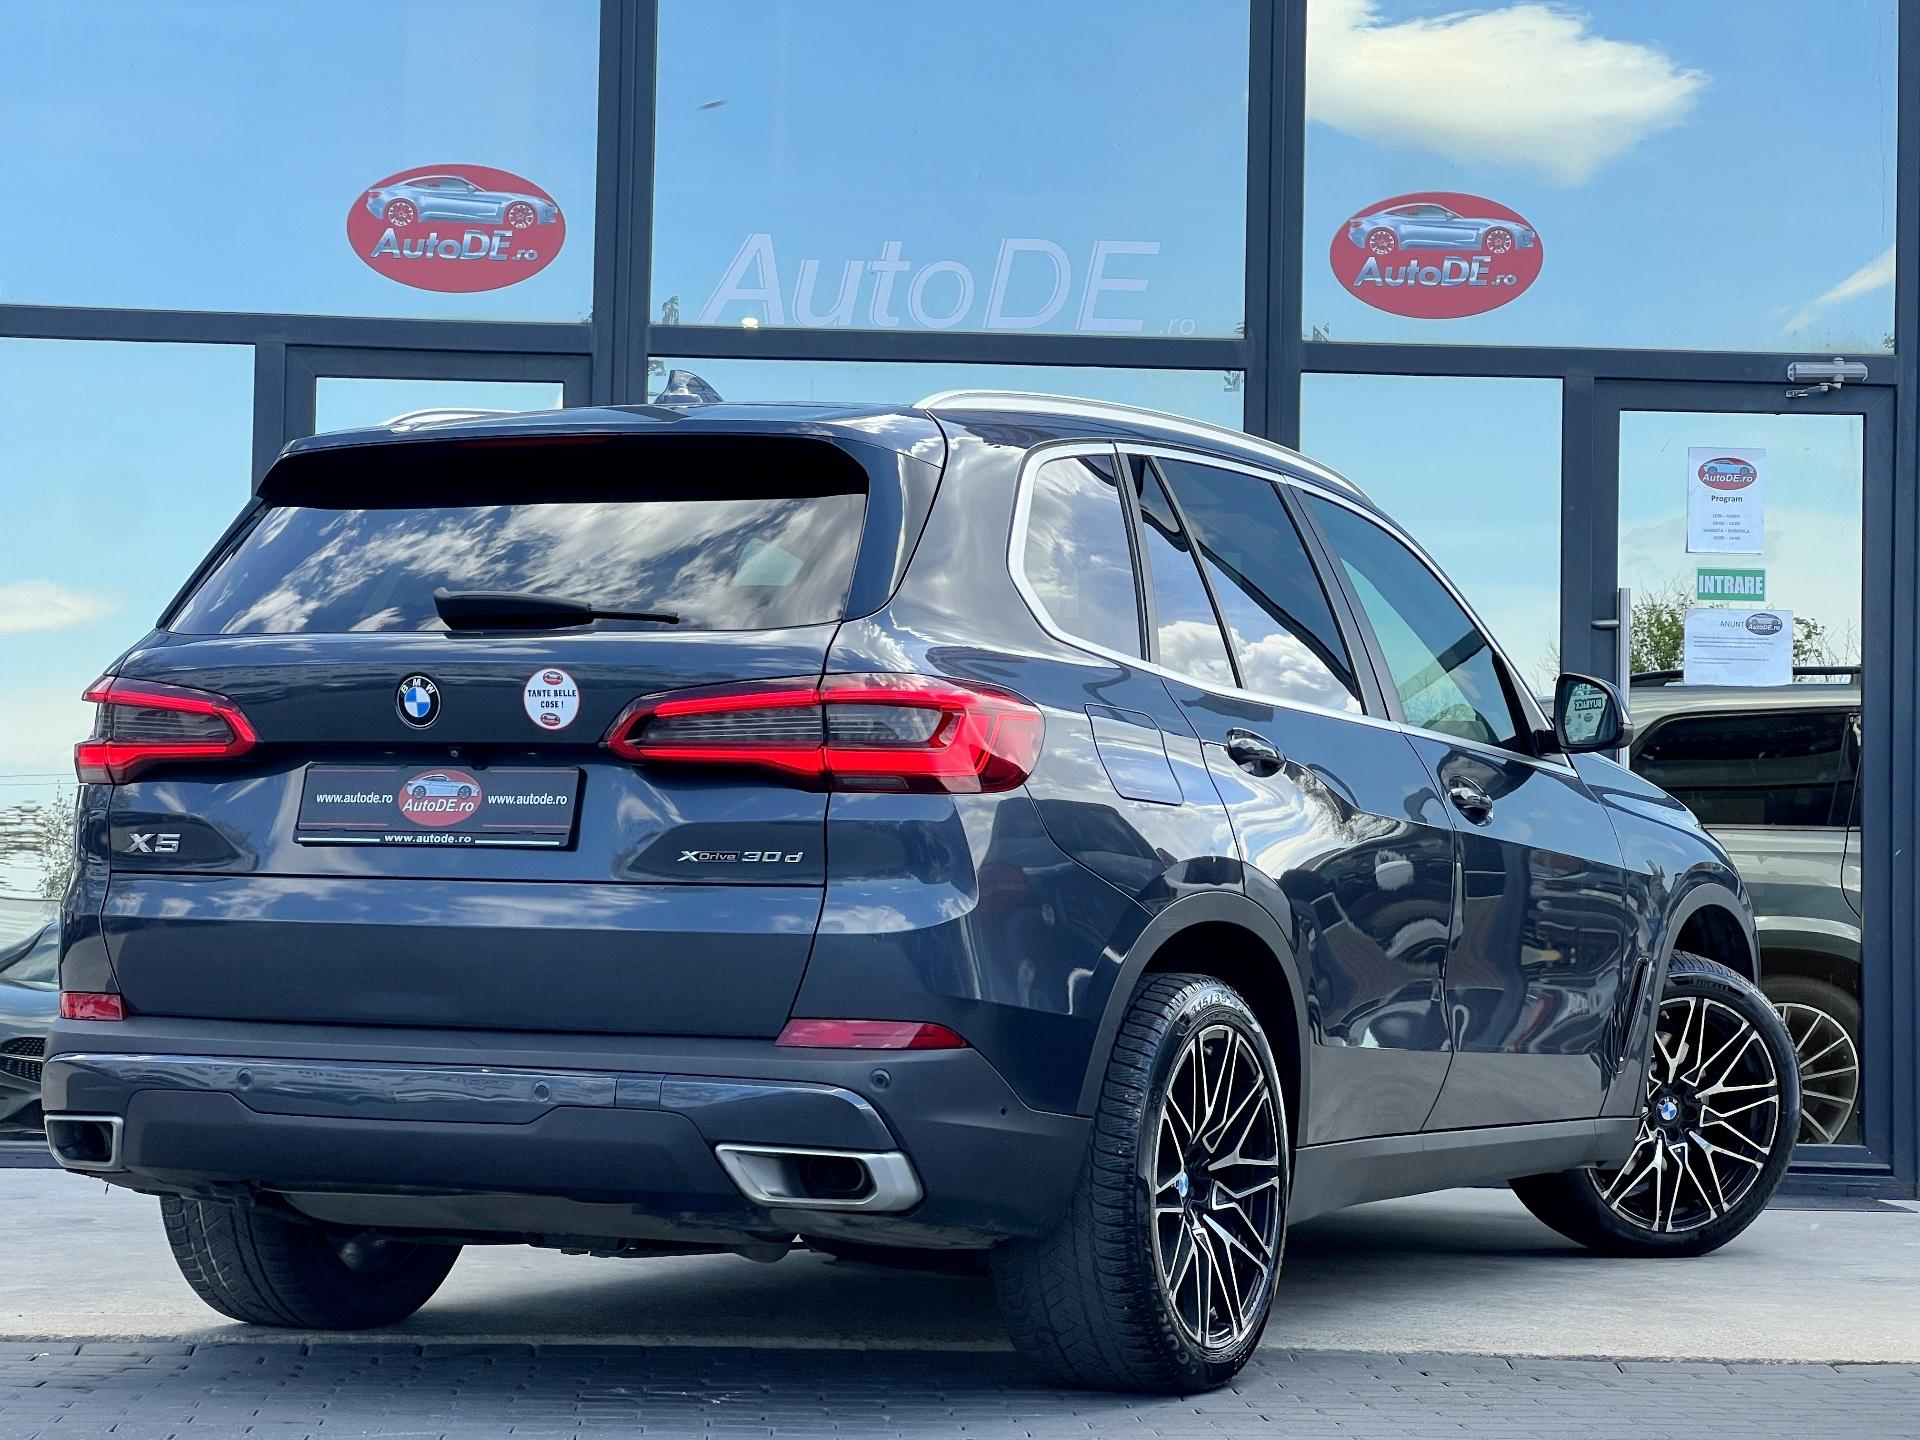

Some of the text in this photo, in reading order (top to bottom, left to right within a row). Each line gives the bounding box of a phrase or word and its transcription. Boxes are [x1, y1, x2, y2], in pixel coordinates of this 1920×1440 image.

[1702, 473, 1753, 483] AutoDE.ro
[1711, 494, 1743, 503] Program
[1698, 575, 1764, 595] INTRARE
[400, 678, 436, 695] BMW
[527, 689, 577, 697] TANTE BELLE
[540, 700, 560, 708] COSE
[316, 792, 567, 813] www.autode.ro AutoDE.ro www.autode.ro
[122, 833, 181, 853] X5
[384, 834, 472, 844] www.autode.ro
